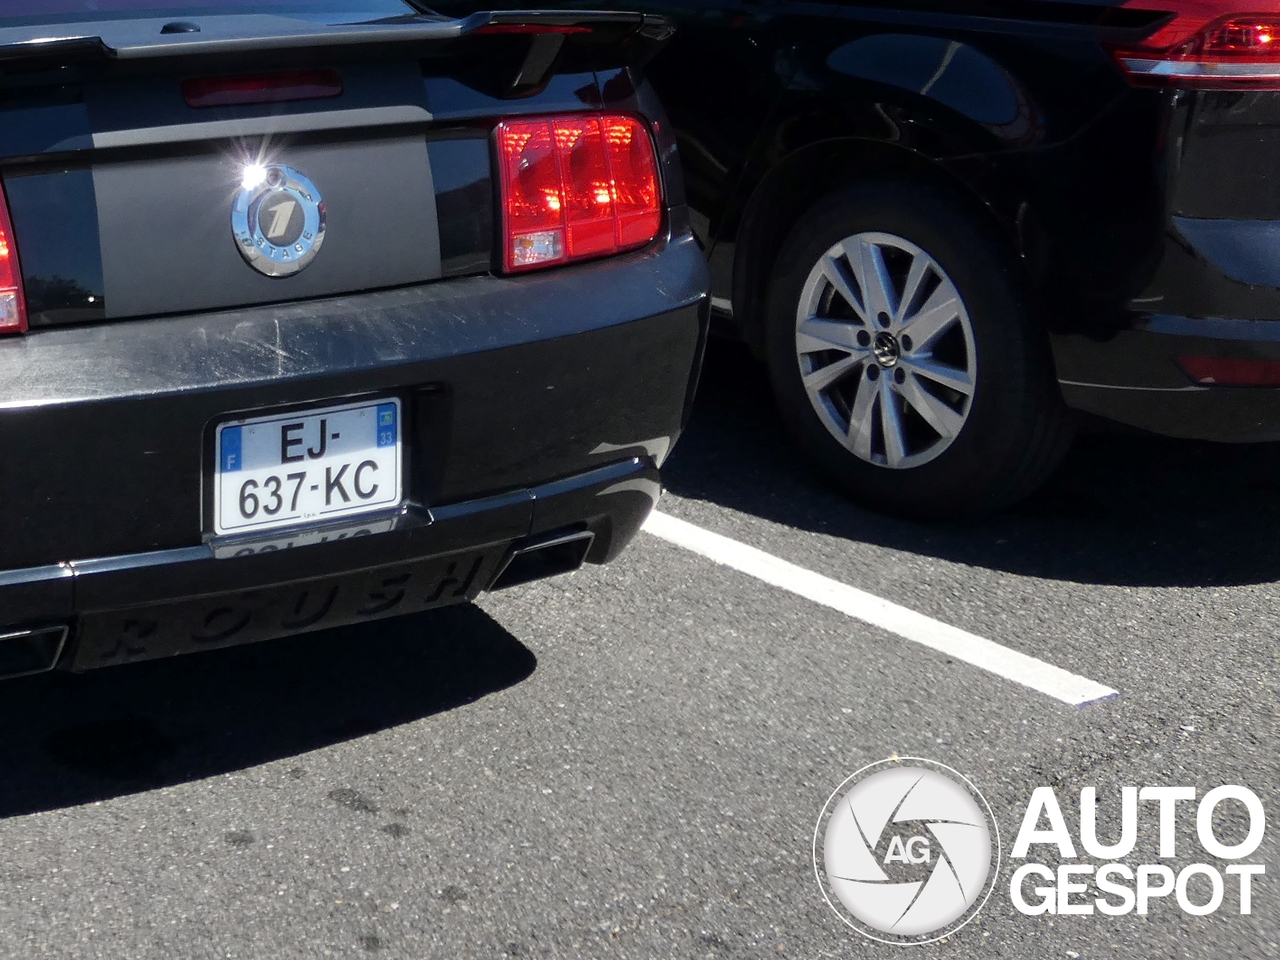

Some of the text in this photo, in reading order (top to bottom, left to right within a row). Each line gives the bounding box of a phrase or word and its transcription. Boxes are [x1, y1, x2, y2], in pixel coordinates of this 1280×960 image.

[256, 230, 314, 260] STAGE
[380, 430, 393, 446] 33
[226, 453, 237, 471] F
[238, 459, 380, 520] 637-KC
[99, 554, 485, 660] ROUSH
